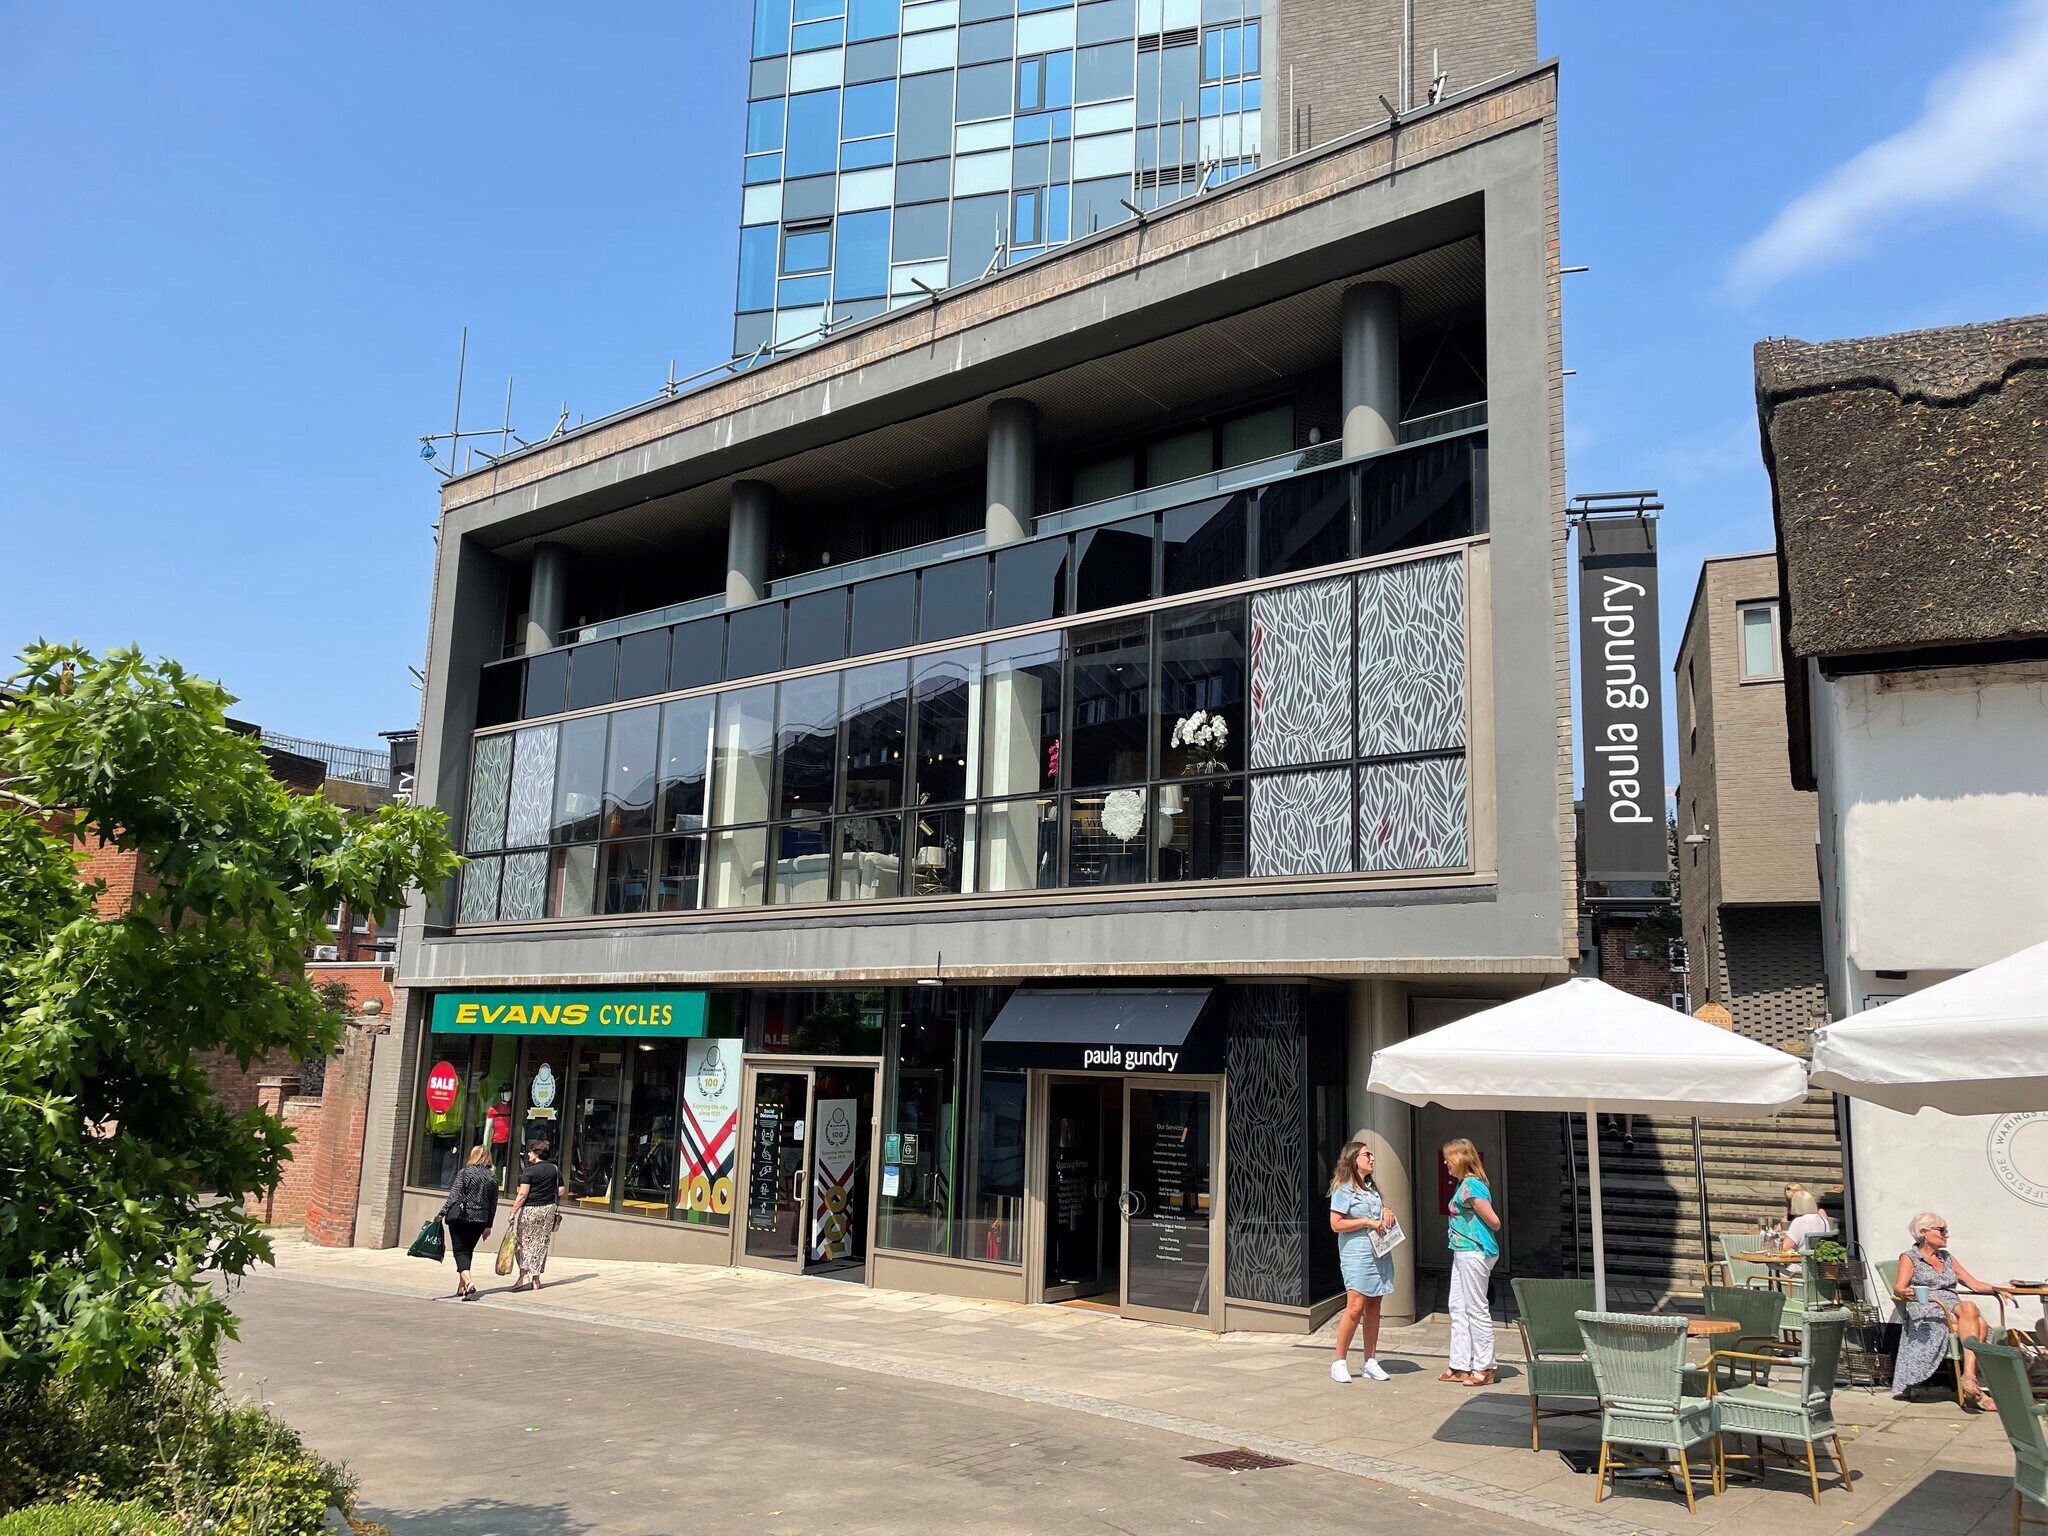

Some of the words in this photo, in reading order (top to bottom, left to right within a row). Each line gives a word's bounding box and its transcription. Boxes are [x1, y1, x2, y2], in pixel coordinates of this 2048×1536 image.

[1591, 575, 1649, 709] gundry
[1595, 723, 1653, 823] paula
[455, 1003, 590, 1025] EVANS
[599, 1004, 673, 1026] CYCLES
[764, 1033, 790, 1045] ALE
[1084, 1045, 1121, 1068] paula
[1125, 1046, 1178, 1072] gundry
[430, 1076, 455, 1091] SALE
[705, 1078, 719, 1087] 100
[832, 1131, 844, 1139] 100
[678, 1174, 735, 1214] 100
[824, 1185, 848, 1260] 100
